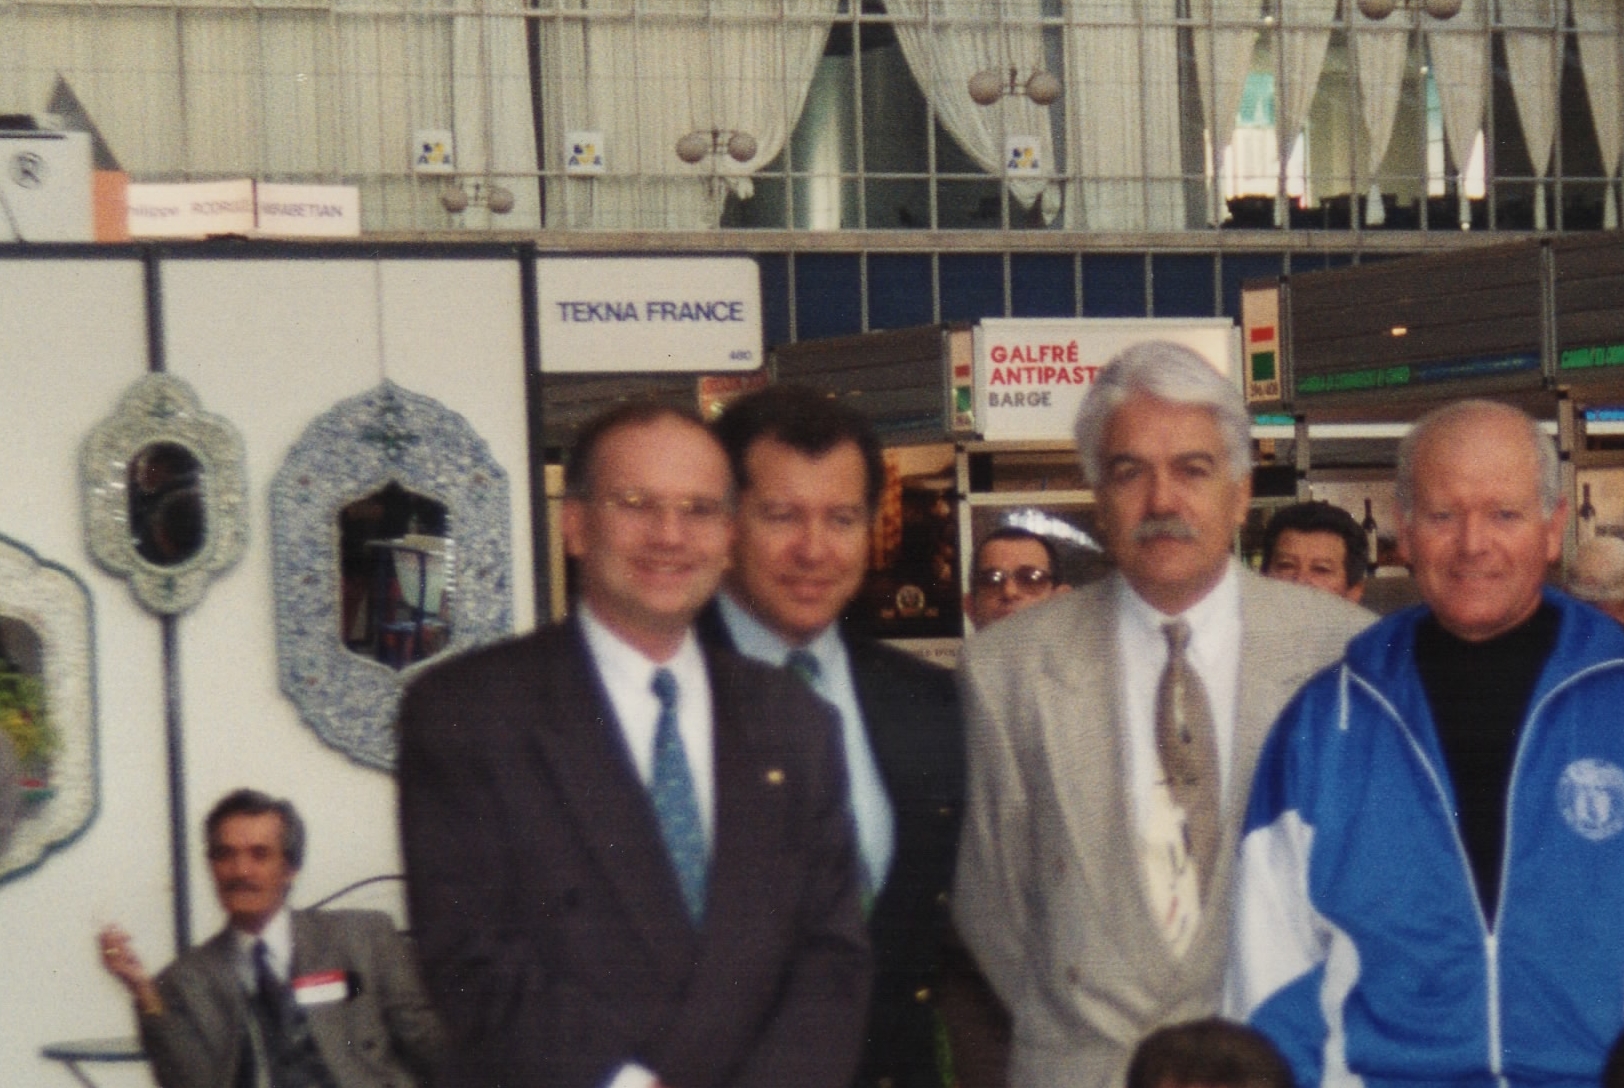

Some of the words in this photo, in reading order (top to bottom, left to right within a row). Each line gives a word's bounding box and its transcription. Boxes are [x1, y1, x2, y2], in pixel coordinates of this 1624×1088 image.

[556, 301, 639, 322] TEKNA
[646, 301, 744, 322] FRANCE
[990, 340, 1079, 364] GALFRÉ
[988, 391, 1052, 407] BARGE
